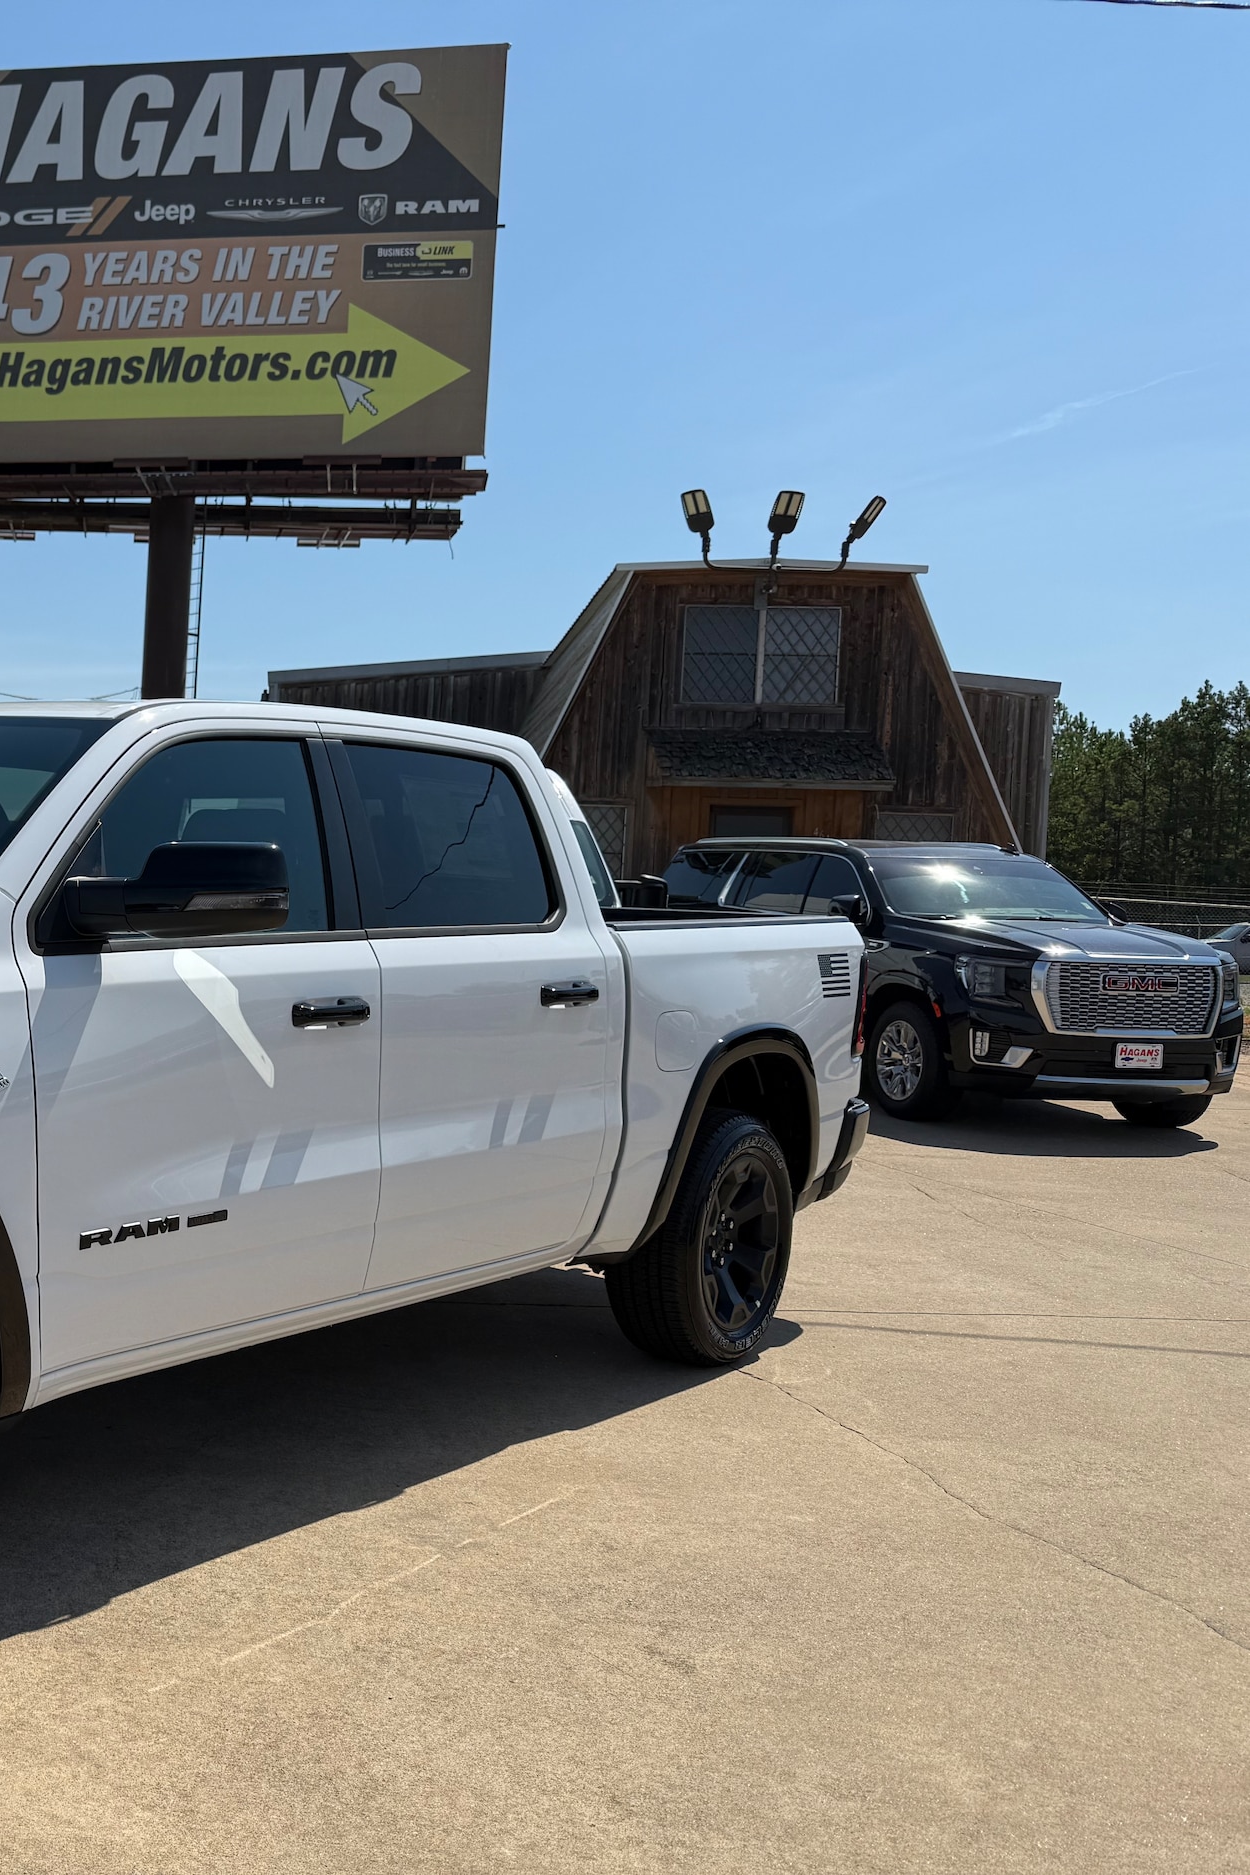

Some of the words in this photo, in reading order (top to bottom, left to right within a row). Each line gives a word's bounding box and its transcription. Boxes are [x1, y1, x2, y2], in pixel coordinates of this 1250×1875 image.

[224, 196, 326, 207] CHRYSLER
[395, 199, 480, 215] RAM
[134, 199, 196, 224] Jeep
[377, 247, 414, 257] BUSINESS
[433, 245, 455, 255] LINK
[84, 249, 202, 287] YEARS
[212, 247, 255, 282] IN
[267, 244, 339, 280] THE
[77, 293, 188, 331] RIVER
[201, 289, 341, 327] VALLEY
[1106, 976, 1177, 991] GMC
[1119, 1047, 1160, 1057] HAGANS
[79, 1214, 181, 1251] RAM
